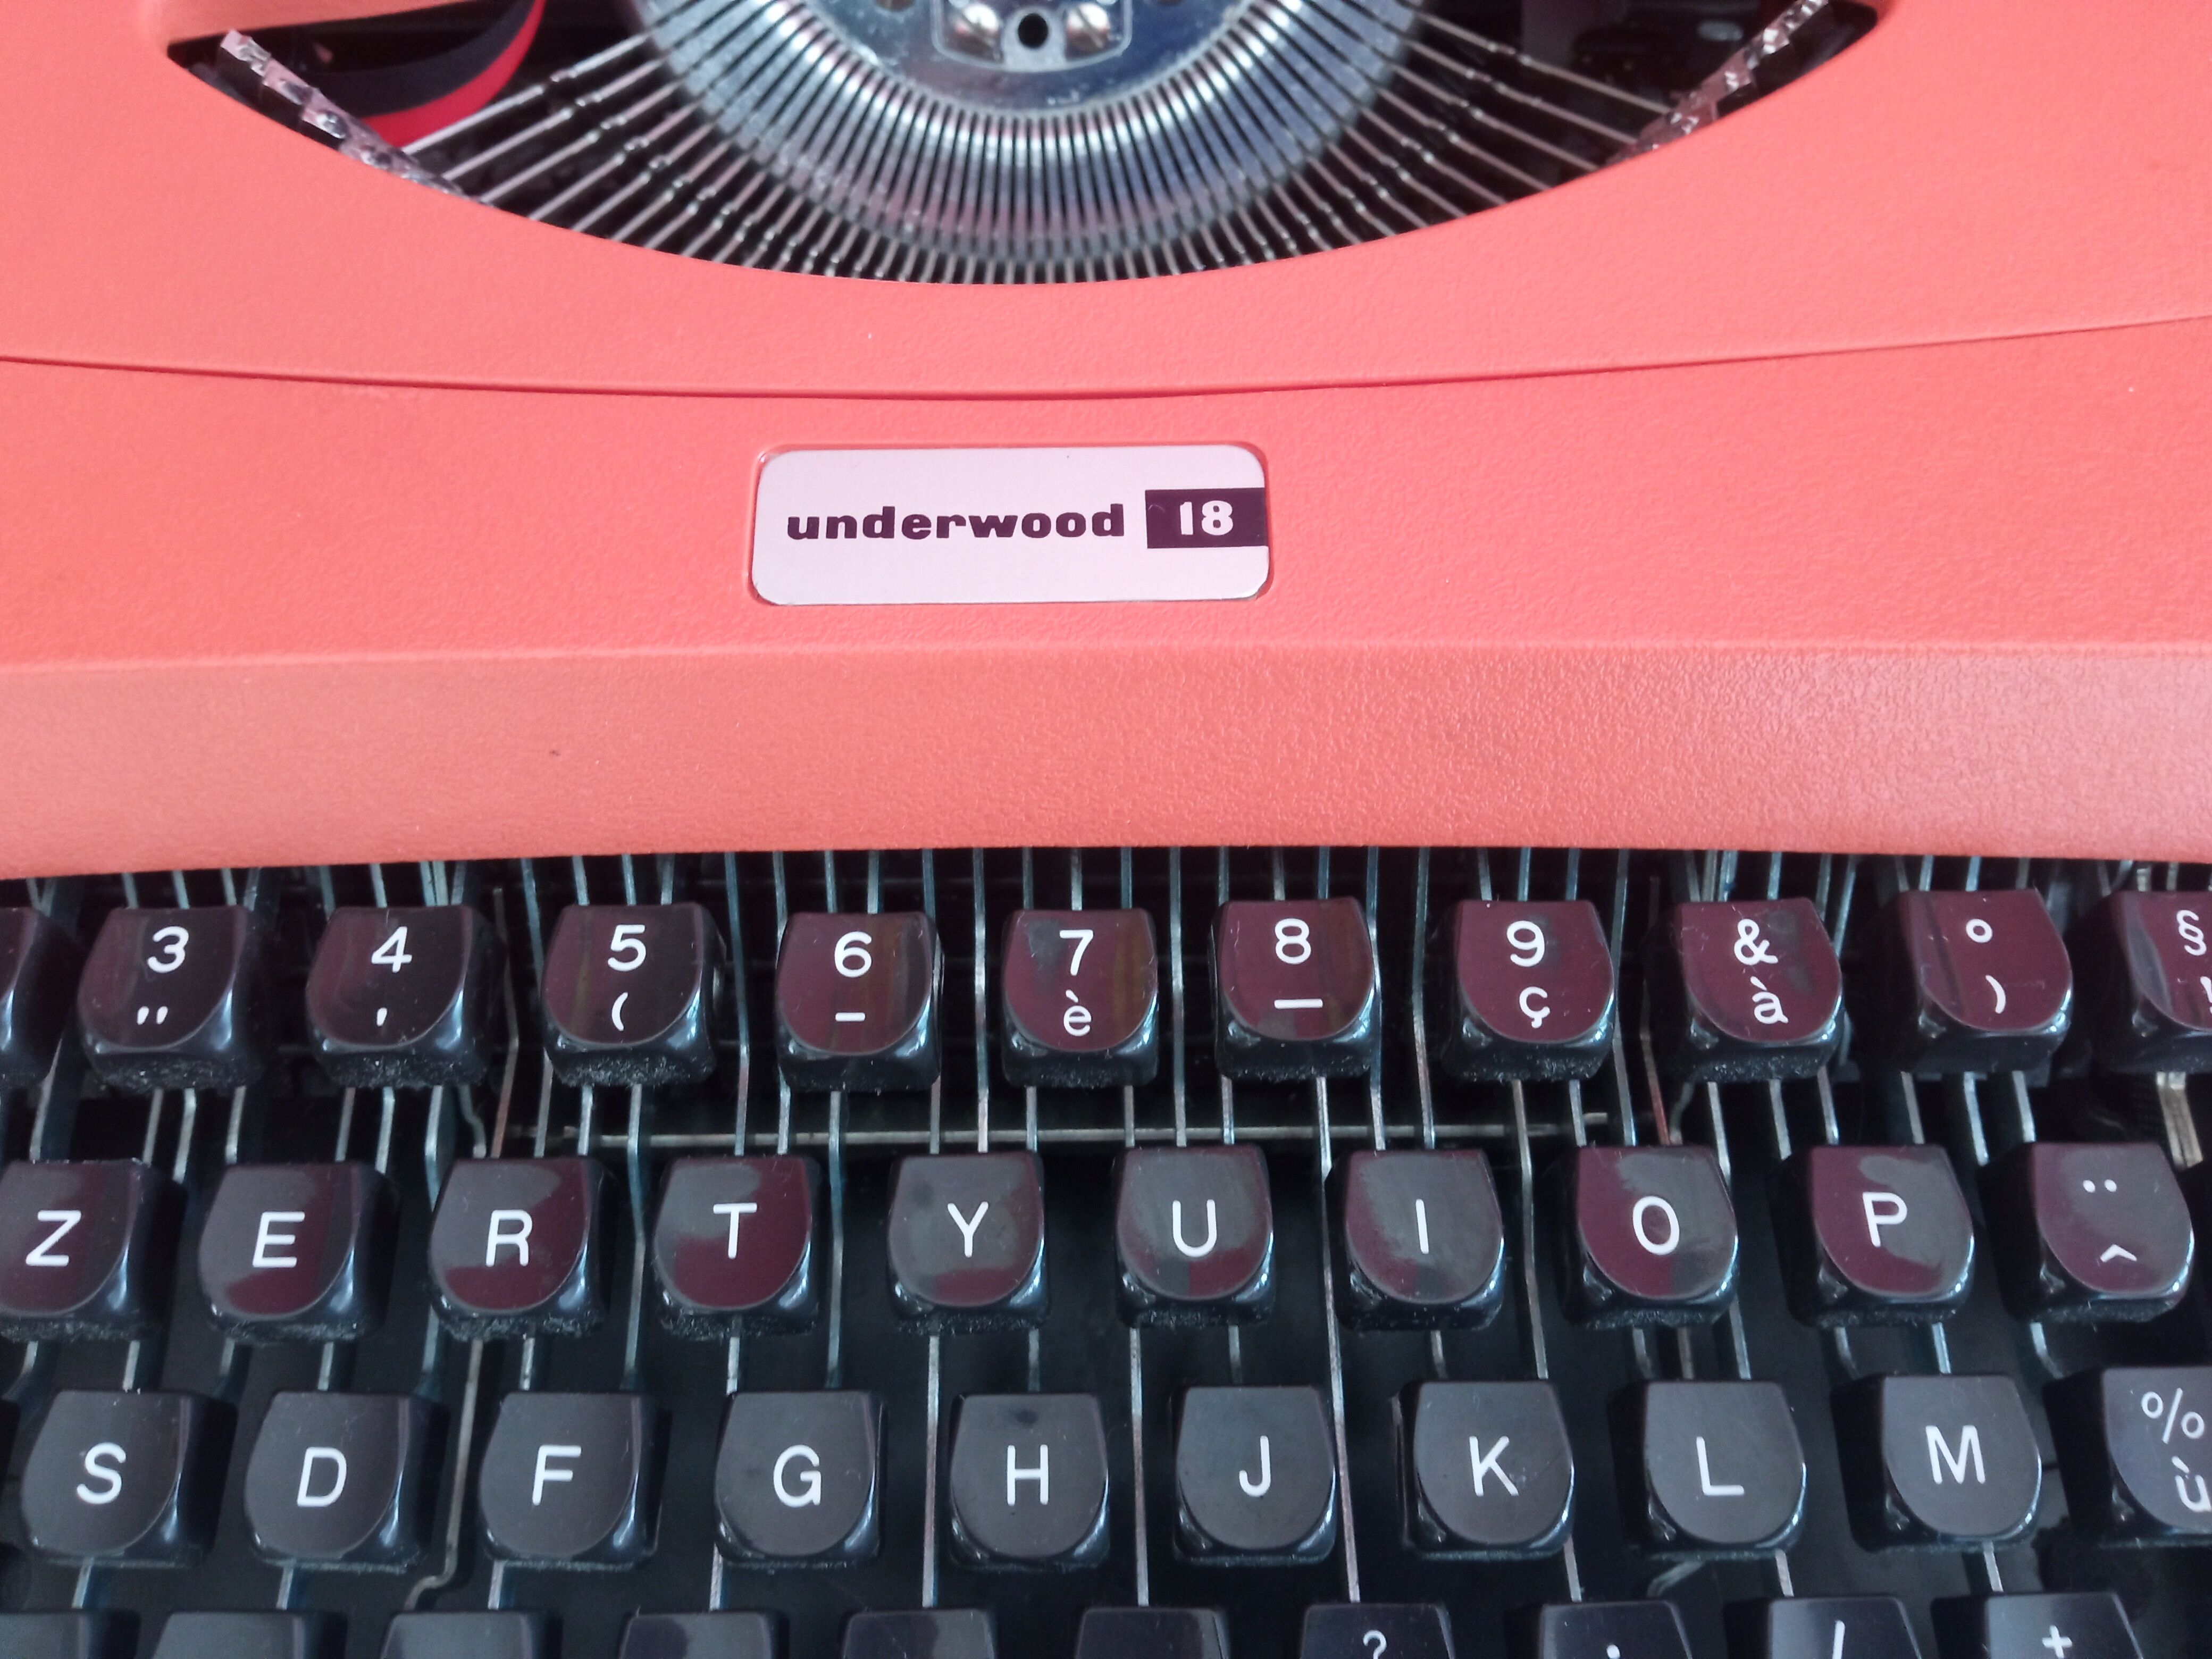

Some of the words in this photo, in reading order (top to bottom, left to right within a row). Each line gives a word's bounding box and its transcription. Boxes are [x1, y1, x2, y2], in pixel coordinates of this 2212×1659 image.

[786, 503, 1125, 540] underwood
[1179, 500, 1234, 537] 18
[147, 926, 189, 973] 3
[371, 926, 413, 973] 4
[607, 924, 647, 971] 5
[834, 931, 873, 978] 6
[1059, 928, 1094, 976] 7
[1274, 918, 1312, 965] 8
[1506, 920, 1546, 967] 9
[1733, 918, 1779, 966] &
[2176, 909, 2207, 956] §
[611, 992, 629, 1032] (
[1063, 989, 1092, 1037] è
[1519, 986, 1551, 1029] ç
[1749, 975, 1789, 1025] à
[1985, 975, 2007, 1015] )
[25, 1210, 82, 1267] Z
[252, 1211, 306, 1268] E
[485, 1209, 533, 1267] R
[712, 1202, 758, 1259] T
[947, 1201, 989, 1258] Y
[1171, 1199, 1218, 1258] U
[1415, 1199, 1430, 1254] I
[1632, 1195, 1680, 1255] O
[1862, 1192, 1908, 1247] P
[2141, 1387, 2205, 1443] %
[76, 1443, 127, 1505] S
[296, 1446, 347, 1505] D
[532, 1444, 582, 1505] F
[773, 1444, 822, 1507] G
[1006, 1444, 1049, 1506] H
[1238, 1435, 1271, 1497] J
[1469, 1436, 1519, 1496] K
[1695, 1436, 1745, 1496] L
[1925, 1425, 1986, 1485] M
[2171, 1456, 2212, 1513] ù
